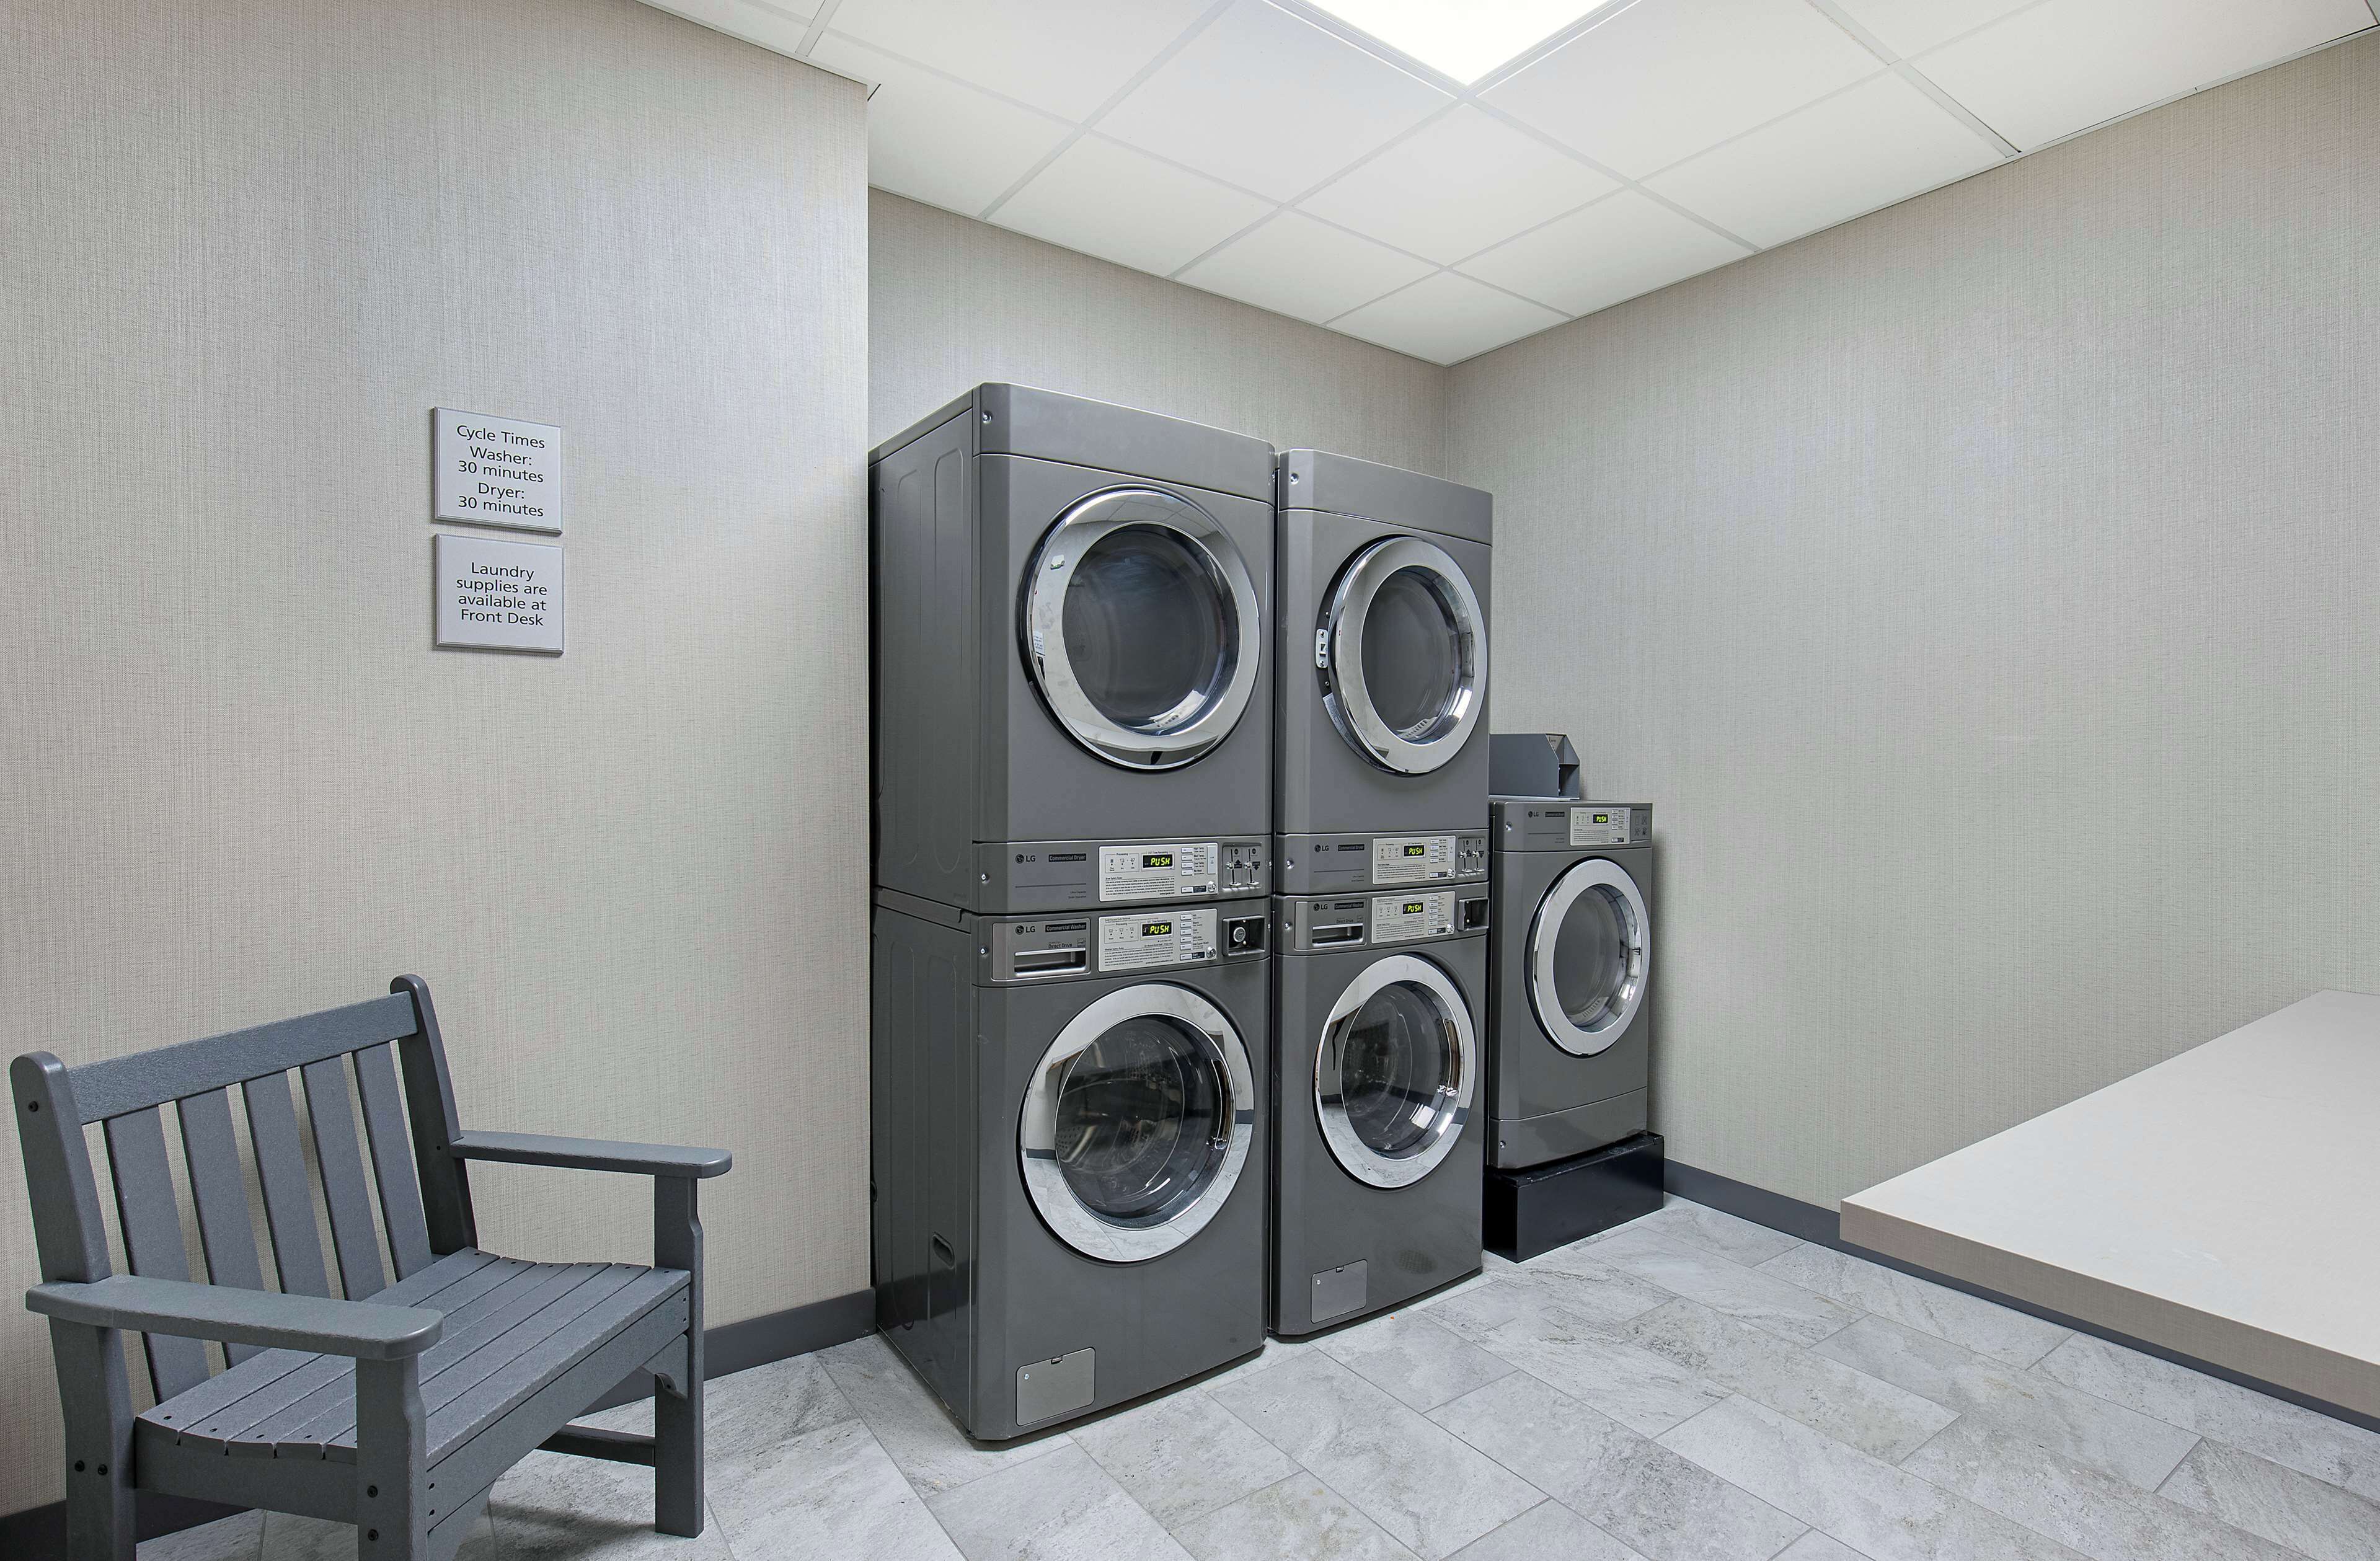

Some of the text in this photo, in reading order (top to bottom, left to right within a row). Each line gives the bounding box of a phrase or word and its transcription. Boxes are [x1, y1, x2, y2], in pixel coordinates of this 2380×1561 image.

[456, 425, 546, 449] Cycle Times
[469, 446, 532, 466] Washer:
[458, 460, 544, 482] 30 minutes
[478, 482, 525, 499] Dryer:
[458, 495, 544, 517] 30 minutes
[471, 562, 534, 582] Laundry
[456, 579, 547, 596] supplies are
[458, 594, 547, 611] available at
[461, 609, 544, 626] Front Desk
[1150, 857, 1170, 866] PUSH
[1407, 904, 1422, 913] PUSH
[1150, 925, 1169, 934] PUSH
